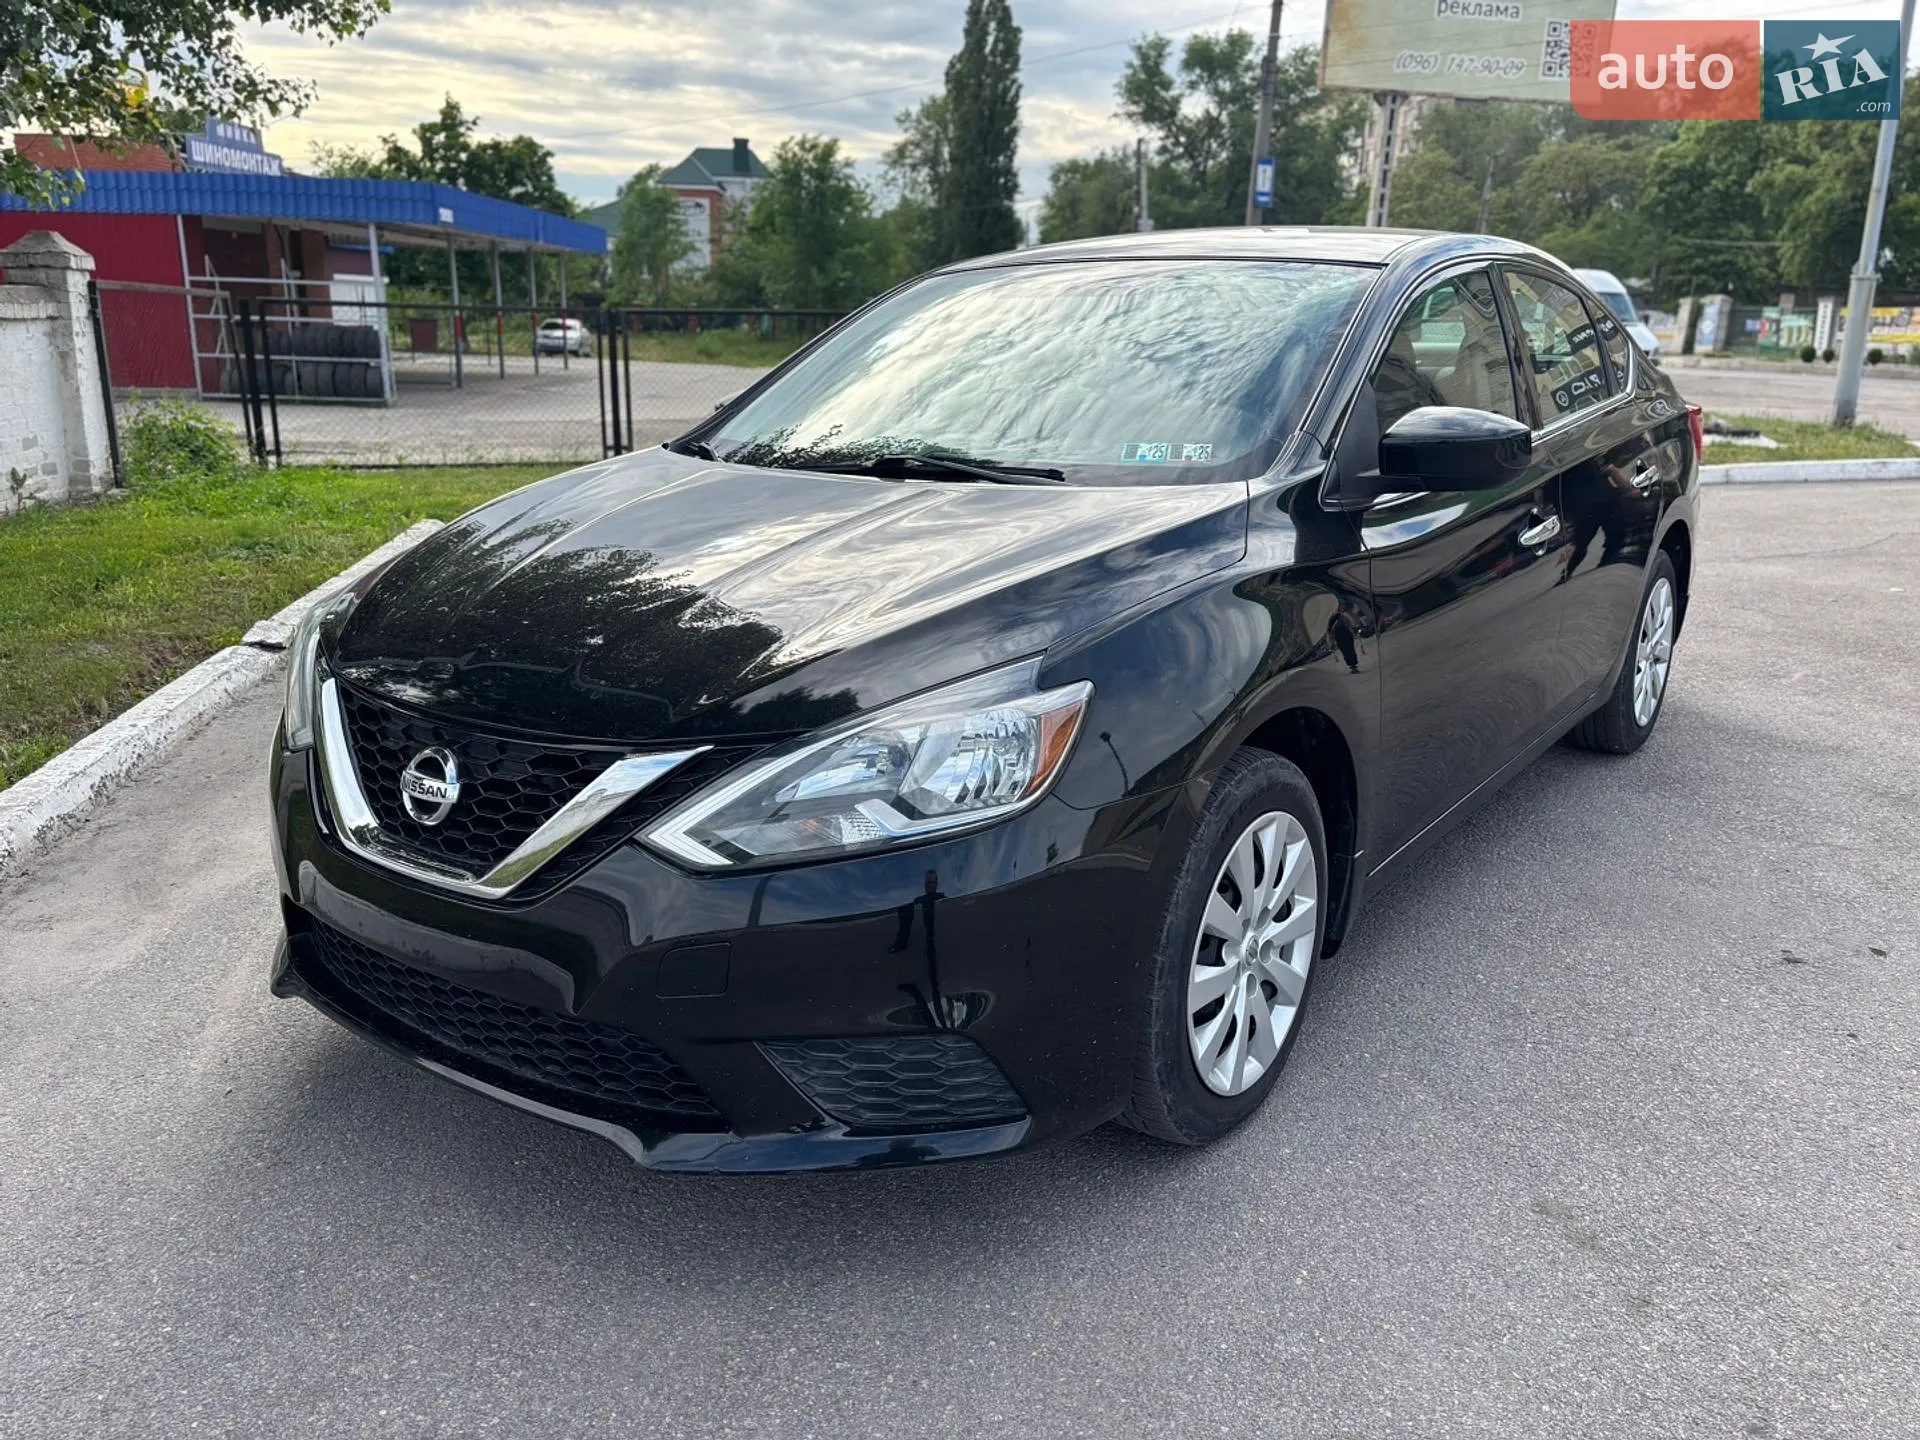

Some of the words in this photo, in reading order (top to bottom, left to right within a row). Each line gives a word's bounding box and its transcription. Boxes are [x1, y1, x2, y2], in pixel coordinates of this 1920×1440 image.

[1437, 0, 1520, 19] реклама
[1395, 53, 1438, 71] (096)
[190, 139, 282, 177] ШИНОМОНТАЖ
[402, 774, 448, 799] NISSAN
